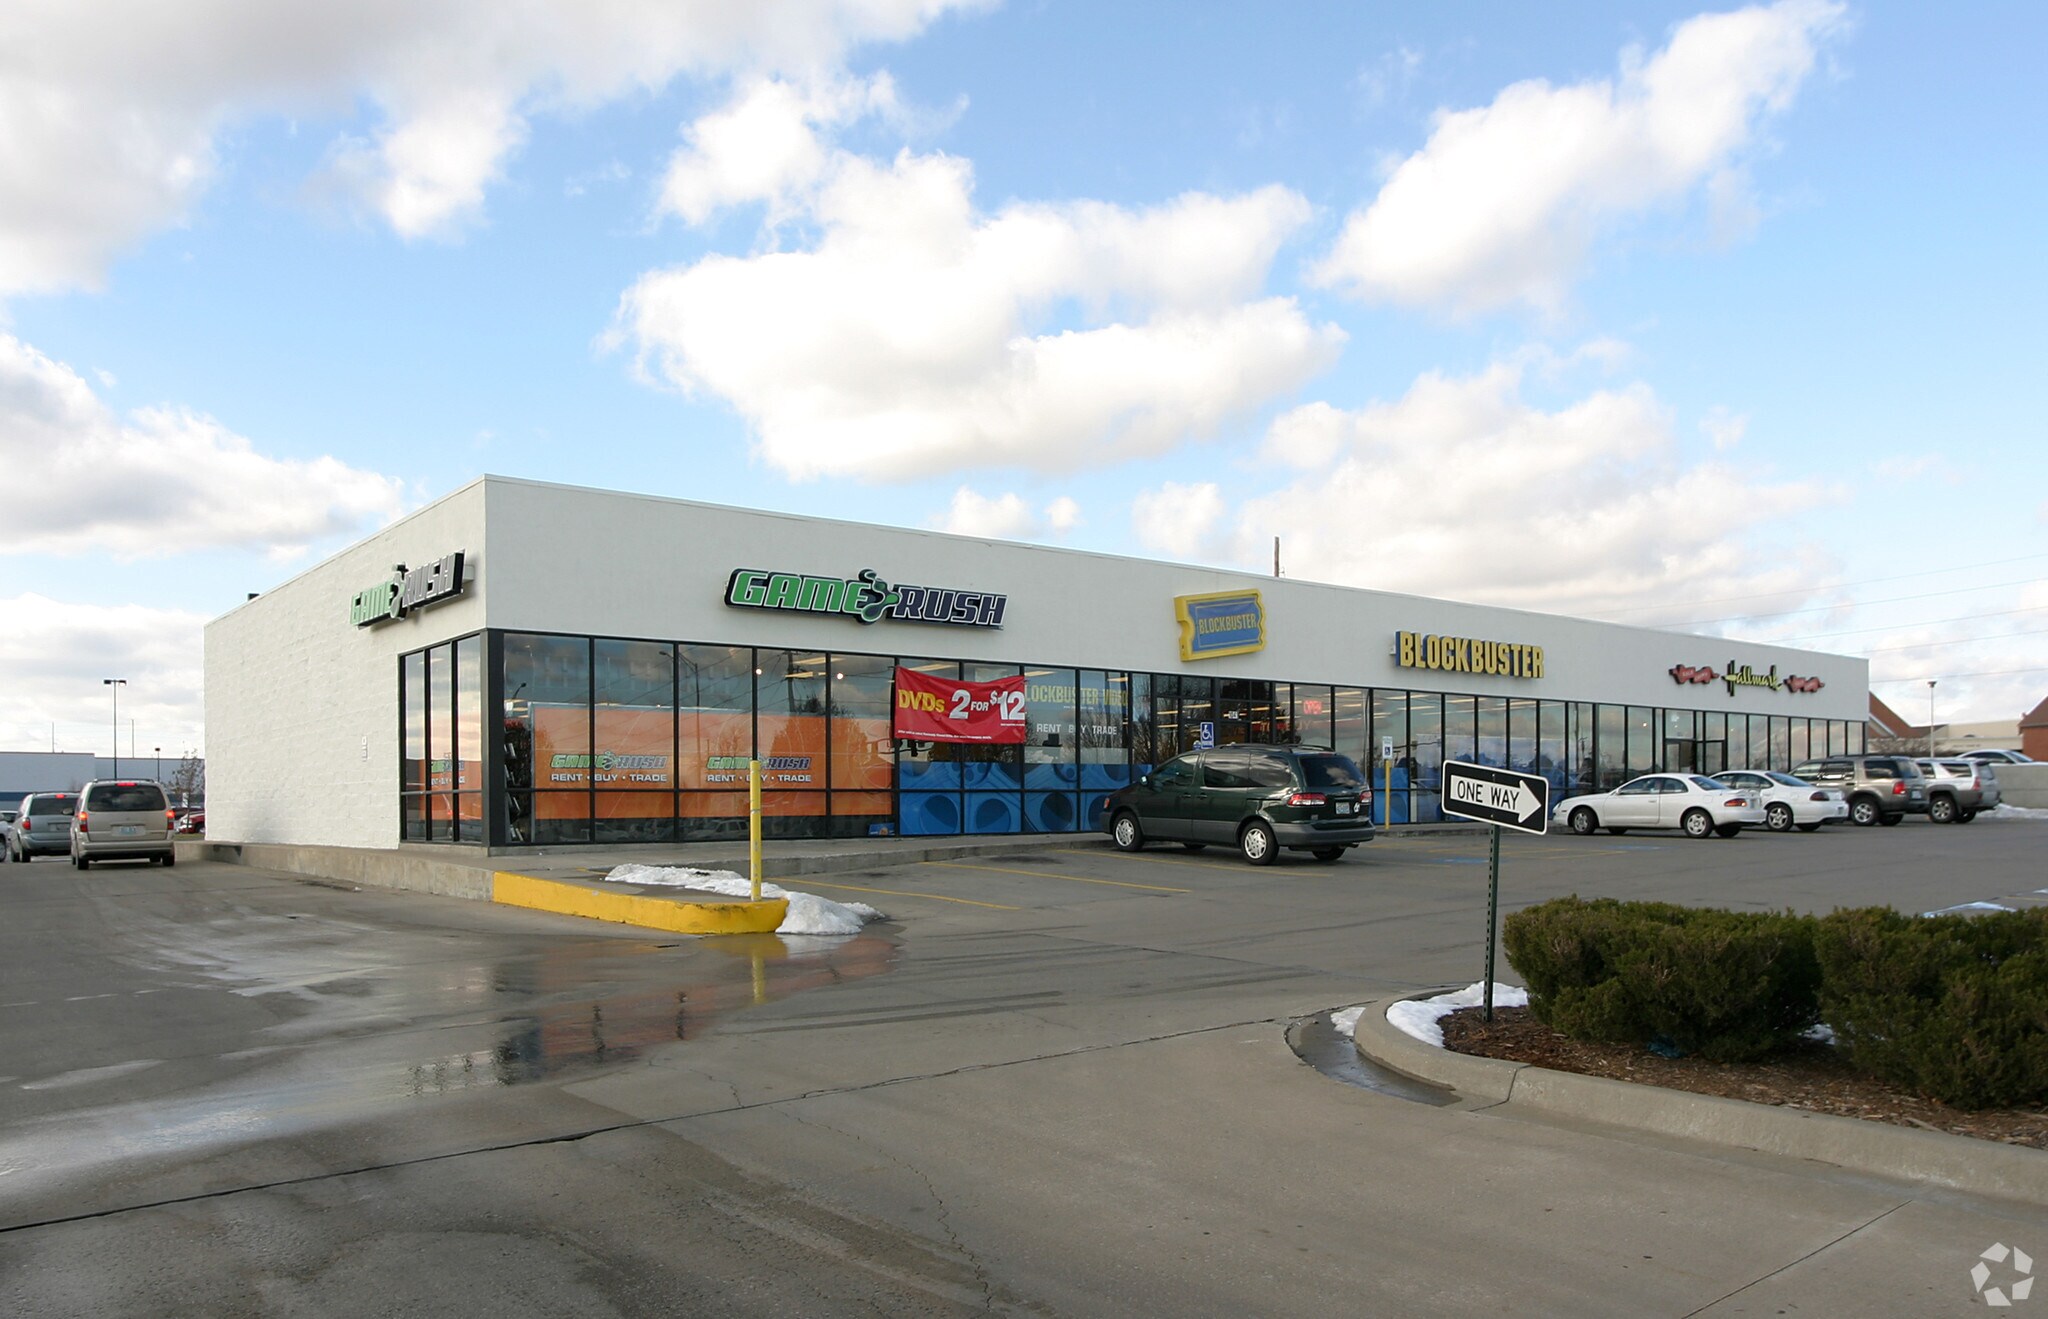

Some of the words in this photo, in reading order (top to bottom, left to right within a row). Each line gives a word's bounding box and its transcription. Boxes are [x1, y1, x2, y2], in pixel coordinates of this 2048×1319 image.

[402, 552, 459, 608] RUSH
[731, 571, 872, 614] GAME
[893, 586, 1008, 626] RUSH
[1199, 613, 1257, 634] BLOCKBUSTER
[1397, 631, 1545, 678] BLOCKBUSTER
[1721, 660, 1783, 697] Hallmark
[898, 689, 945, 712] DVDs
[949, 689, 971, 719] 2
[970, 701, 989, 711] FOR
[990, 690, 1026, 720] $12
[1024, 684, 1099, 705] LOCKBUTER
[1036, 723, 1062, 733] RENT
[1068, 724, 1087, 734] BY
[1092, 725, 1117, 735] TRADE
[615, 755, 668, 769] RUSH
[707, 756, 752, 770] GAM
[551, 773, 583, 782] RENT
[594, 773, 618, 782] BUY
[629, 773, 668, 782] TRADE
[707, 774, 736, 782] RENT
[777, 774, 812, 782] TRADE
[1457, 780, 1483, 803] ONE
[1490, 786, 1520, 810] WAY
